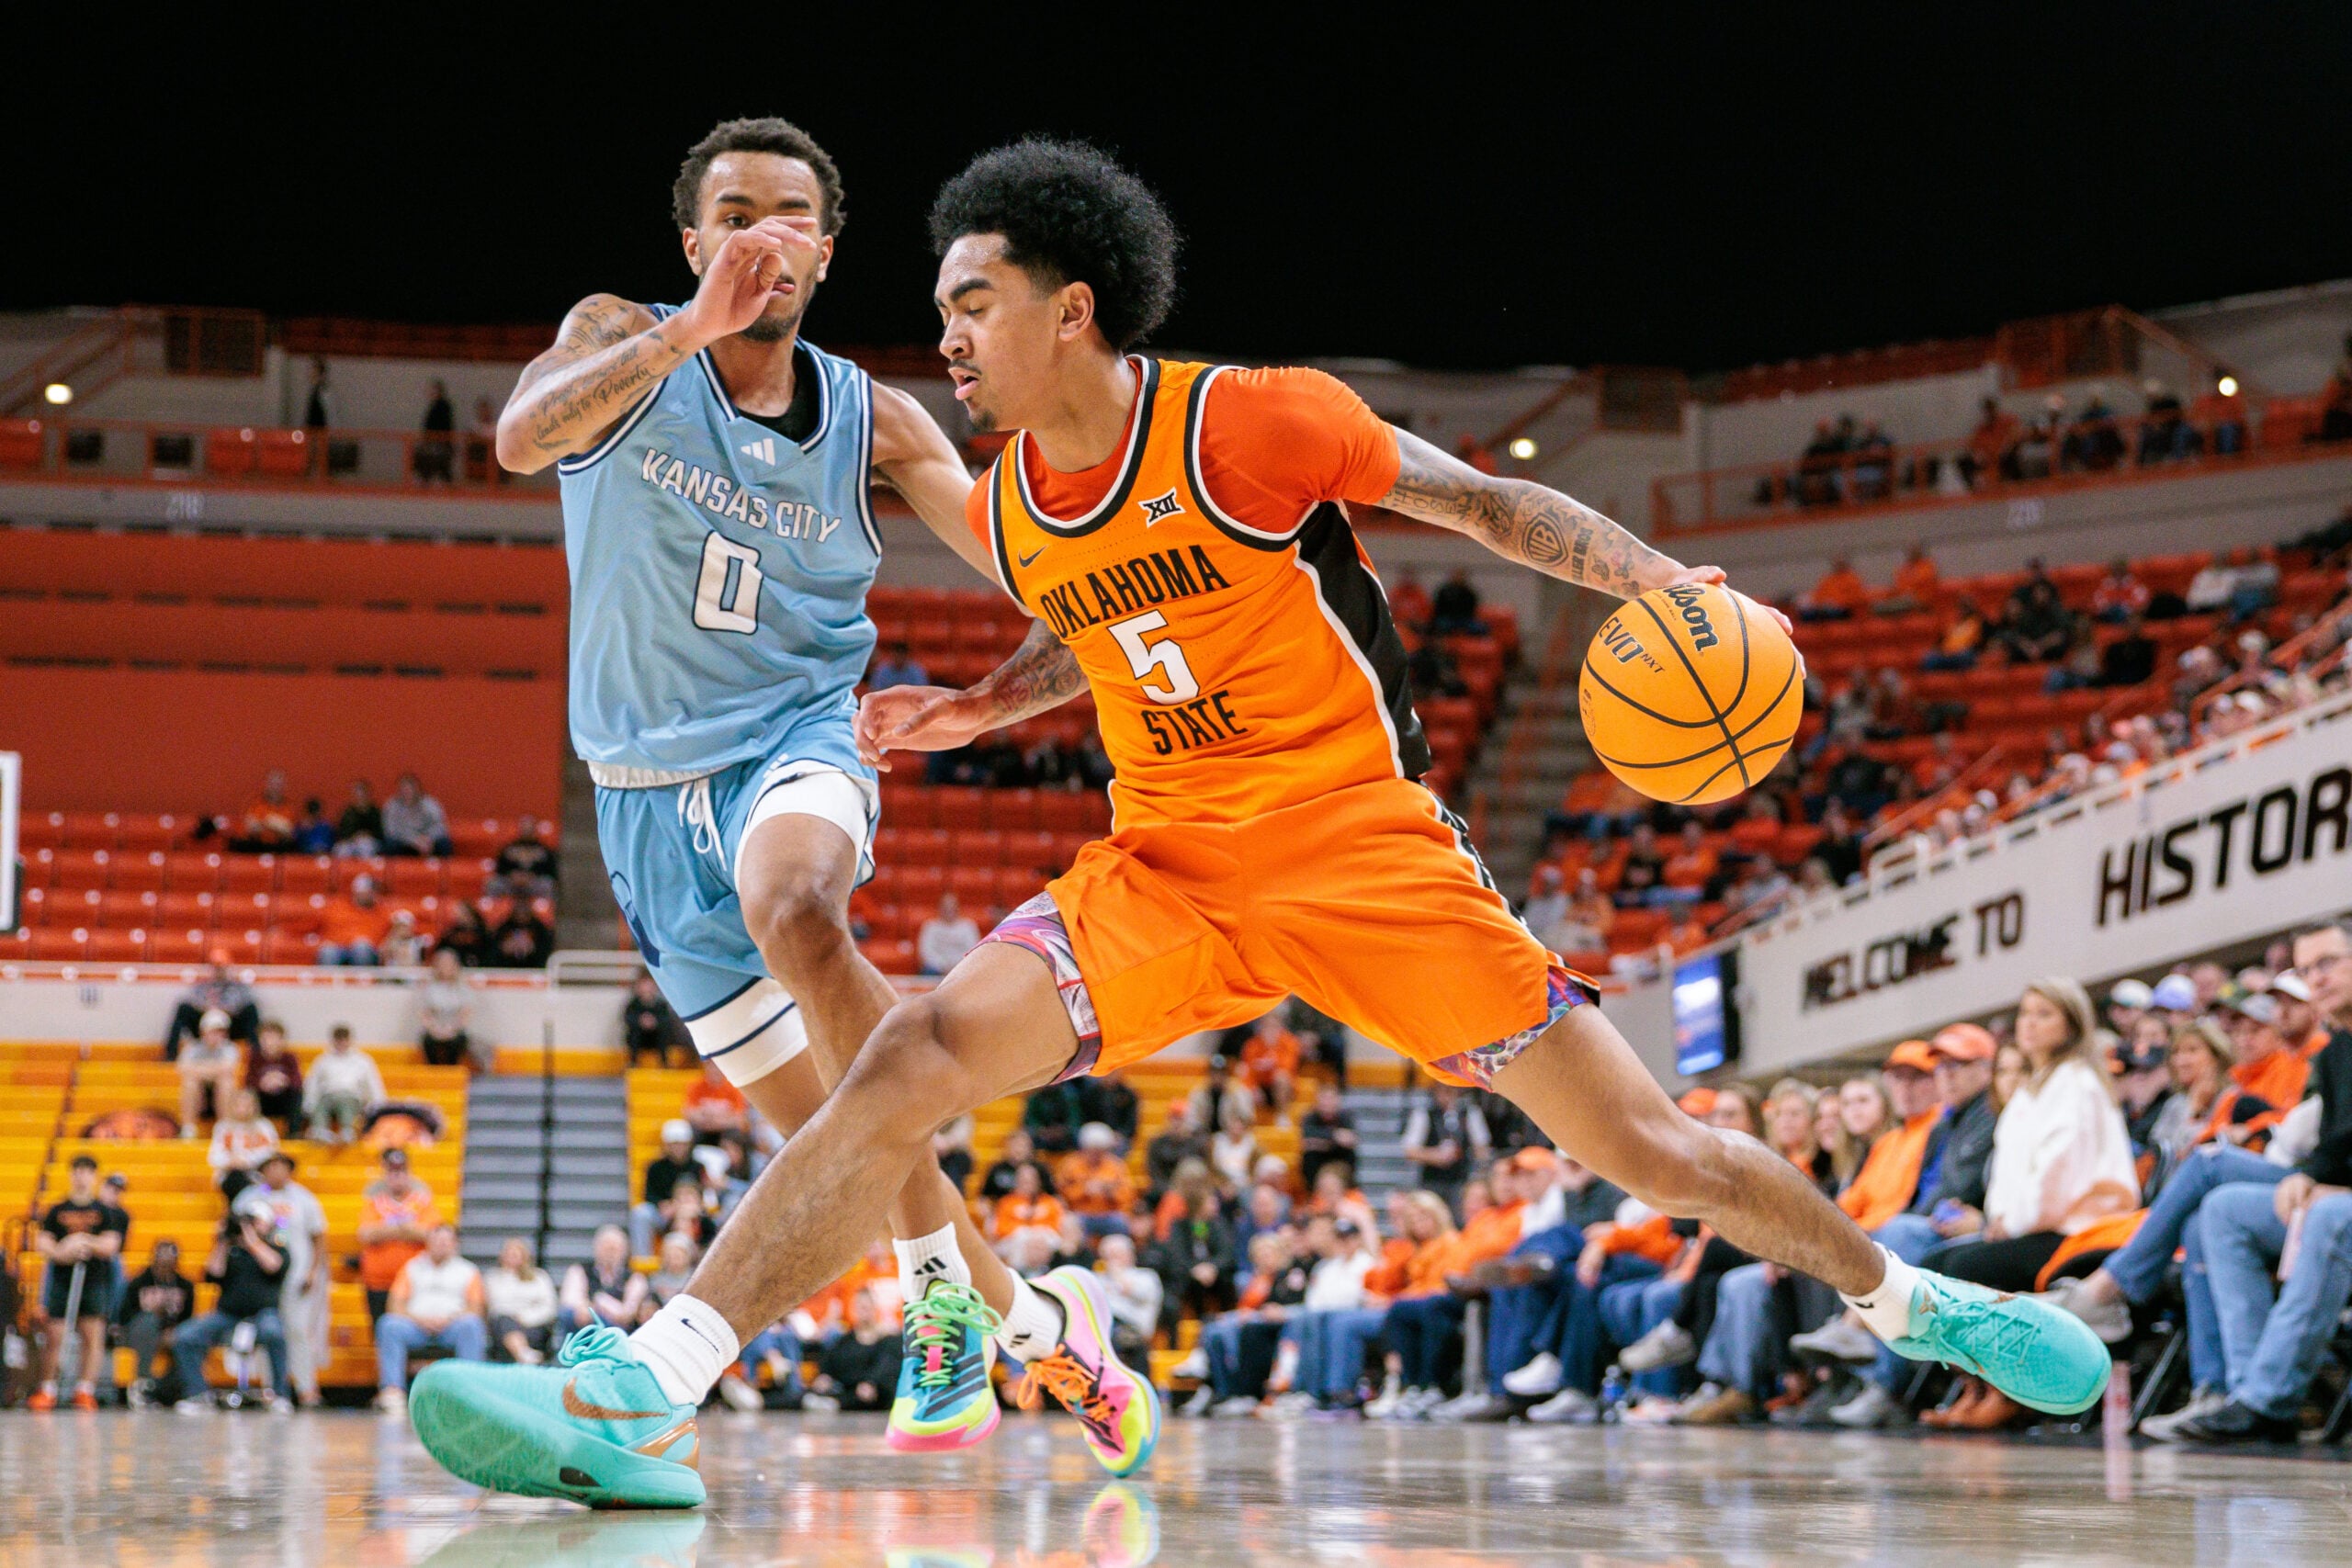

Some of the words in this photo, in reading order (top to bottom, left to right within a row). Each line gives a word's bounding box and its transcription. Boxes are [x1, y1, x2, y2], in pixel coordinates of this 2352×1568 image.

[642, 448, 768, 529] KANSAS
[775, 499, 842, 545] CITY
[1140, 491, 1182, 525] XII
[692, 529, 764, 636] 0
[1040, 545, 1231, 639] OKLAHOMA
[1662, 582, 1720, 652] ilson
[1105, 609, 1201, 706] 5
[1640, 652, 1665, 674] NXT
[1141, 690, 1250, 756] STATE
[1802, 914, 1959, 1012] WELCOME
[1974, 892, 2027, 958] TO
[2098, 767, 2352, 928] HISTOR
